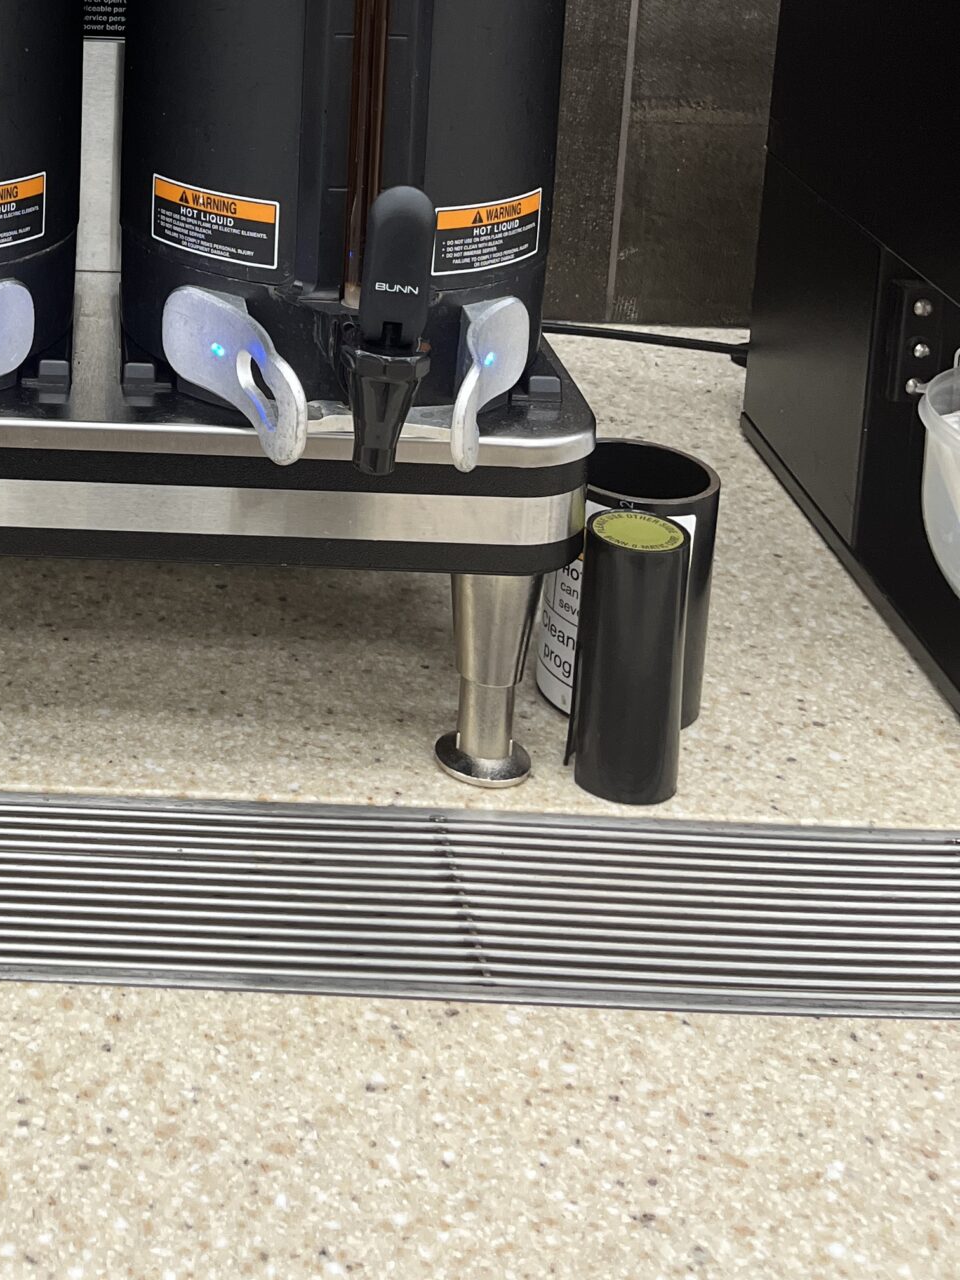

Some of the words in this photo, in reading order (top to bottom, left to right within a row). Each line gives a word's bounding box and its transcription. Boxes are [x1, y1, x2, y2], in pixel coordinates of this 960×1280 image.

[192, 193, 237, 214] WARNING
[486, 202, 521, 221] WARNING
[180, 206, 198, 218] HOT
[201, 212, 234, 226] LIQUID
[473, 226, 491, 236] HOT
[494, 219, 519, 233] LIQUID
[375, 282, 419, 295] BUNN
[626, 514, 659, 524] OTHER
[560, 581, 579, 600] can
[544, 643, 572, 678] prog
